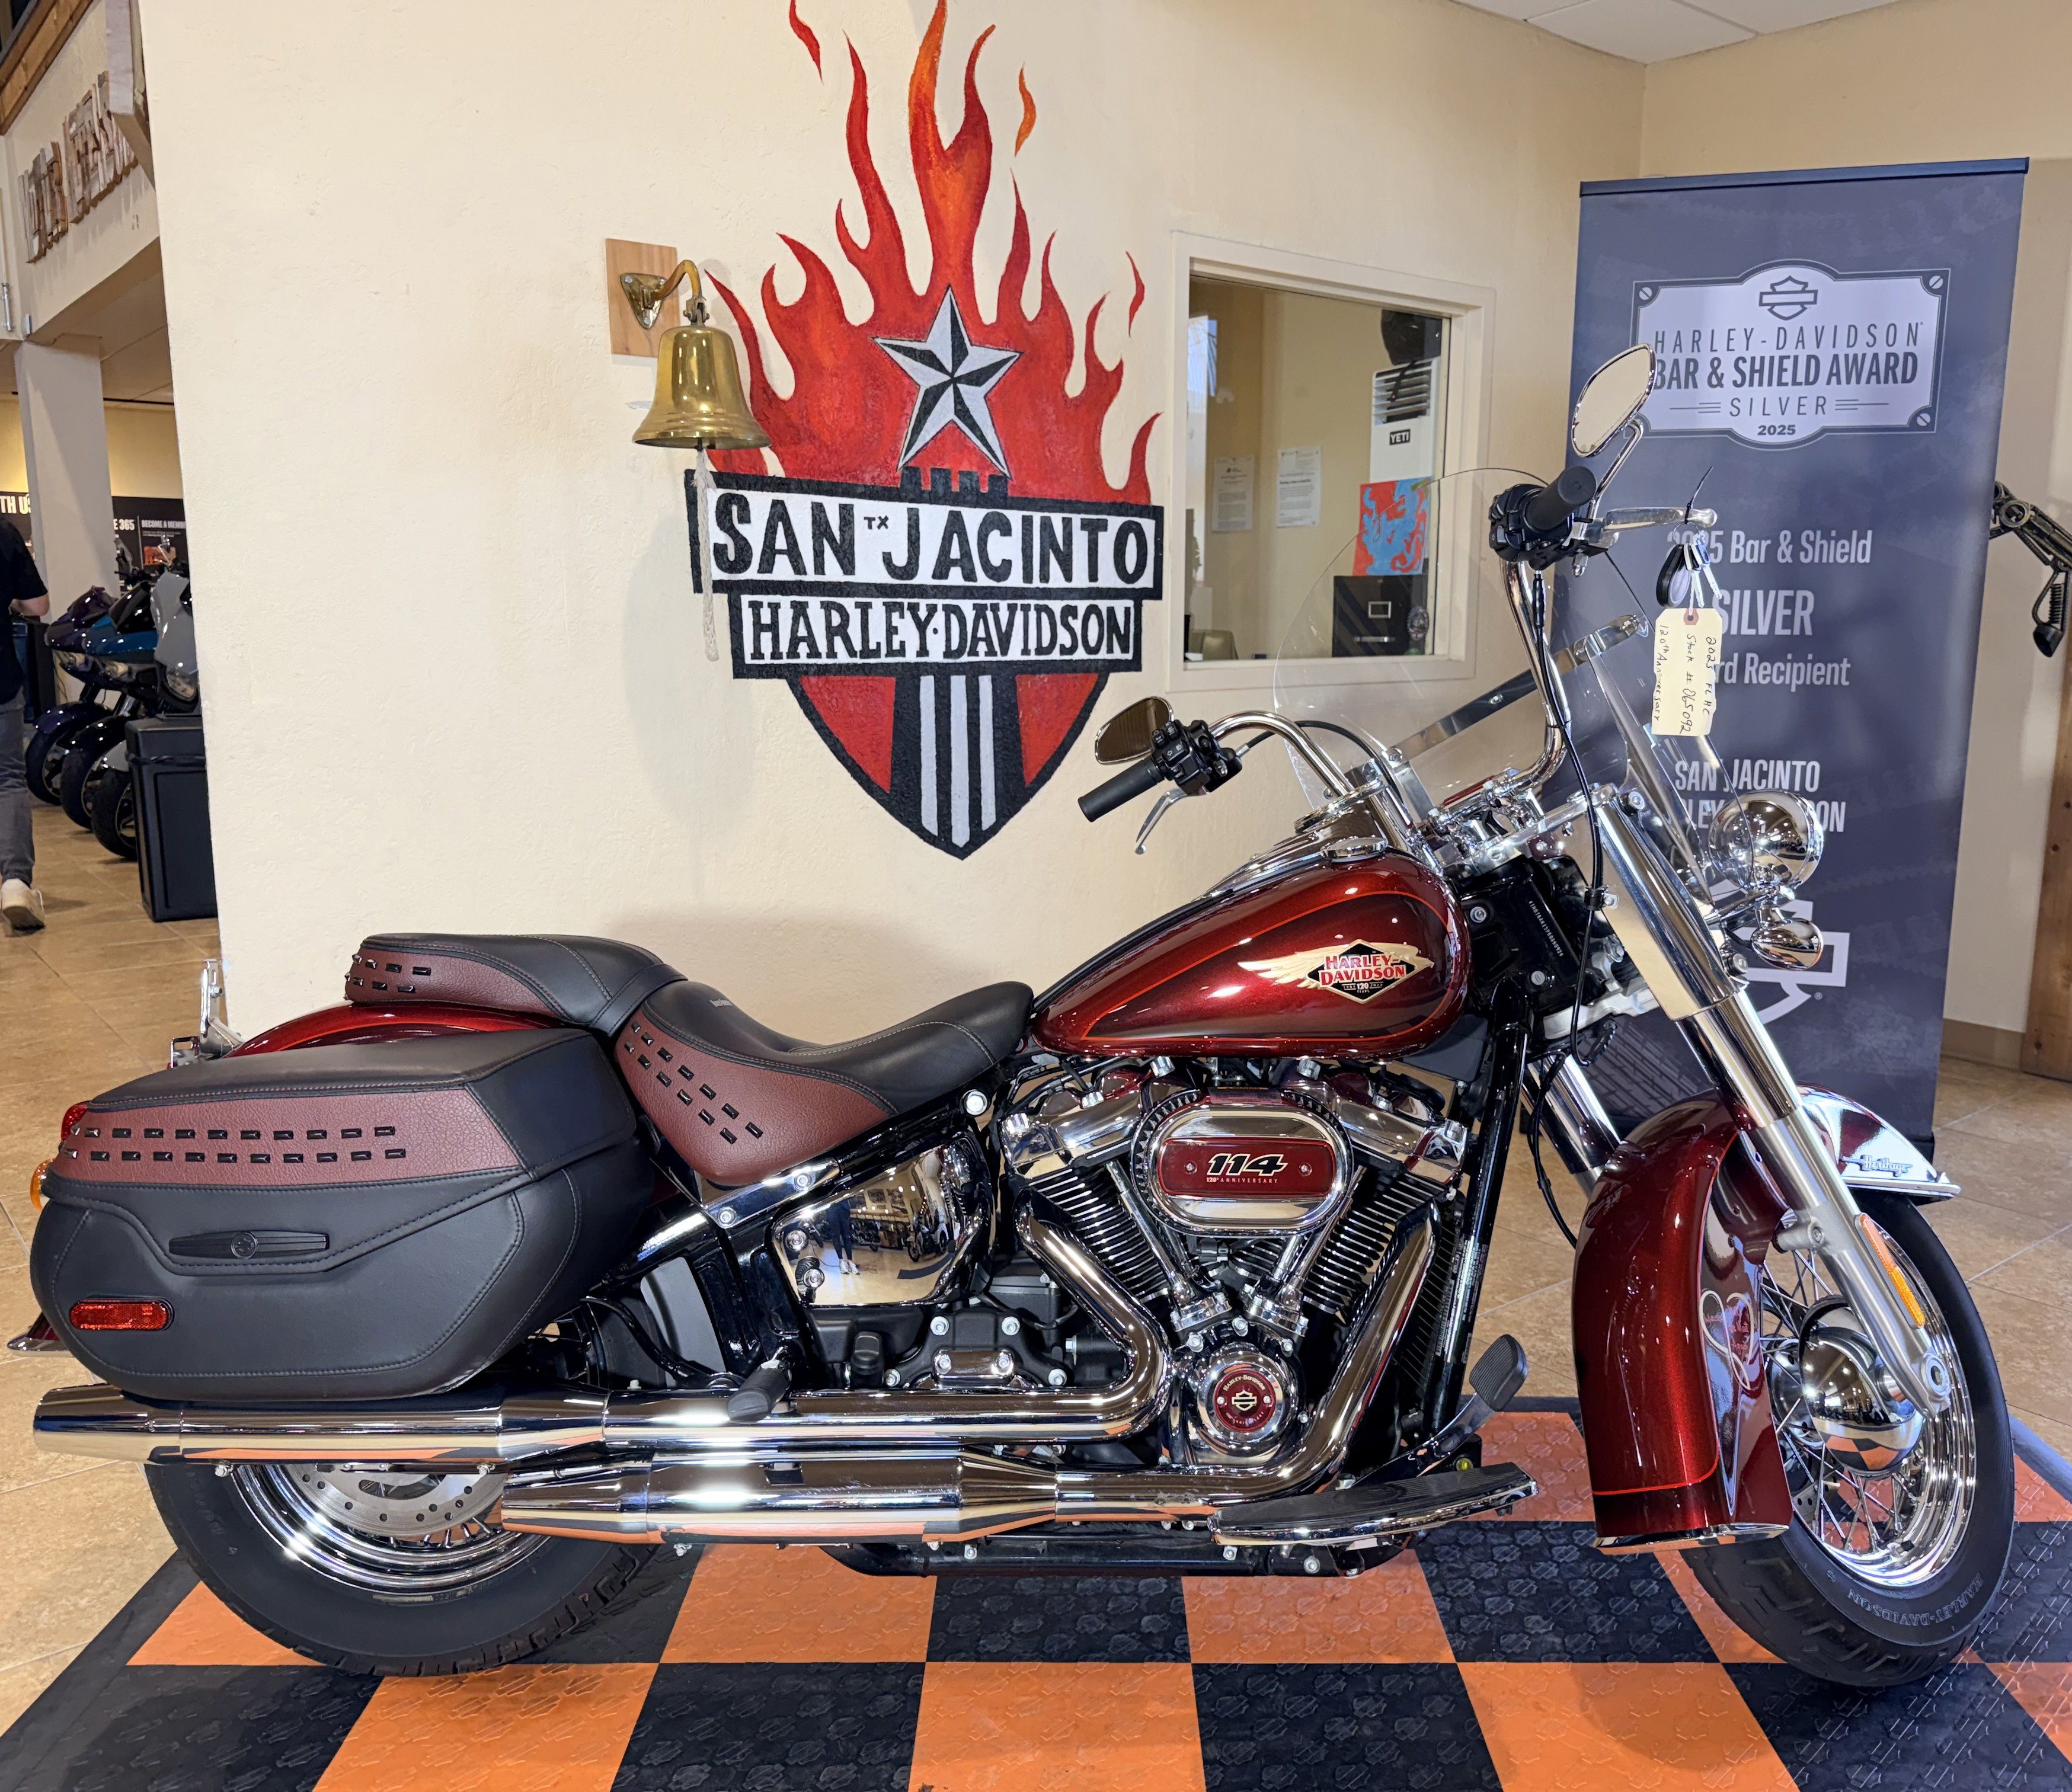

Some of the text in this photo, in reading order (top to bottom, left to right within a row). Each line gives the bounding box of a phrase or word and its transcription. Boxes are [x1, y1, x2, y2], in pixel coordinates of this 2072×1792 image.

[1655, 322, 1918, 354] HARLEY-DAVIDSON
[1654, 352, 1918, 389] BAR & SHIELD AWARD
[1729, 396, 1827, 417] SILVER
[1390, 431, 1409, 443] YETI
[1757, 425, 1796, 436] 2025
[119, 519, 135, 530] 365
[713, 492, 855, 575] SAN
[882, 507, 1148, 584] JACINTO
[1729, 530, 1772, 563] Bar
[1777, 532, 1793, 563] &
[1799, 530, 1872, 564] Shield
[1712, 589, 1815, 636] SILVER
[1686, 633, 1697, 663] Stock
[1744, 653, 1851, 692] Recipient
[1675, 759, 1821, 792] SAN JACINTO
[1320, 966, 1405, 985] DAVIDSON
[1207, 1153, 1288, 1176] 114
